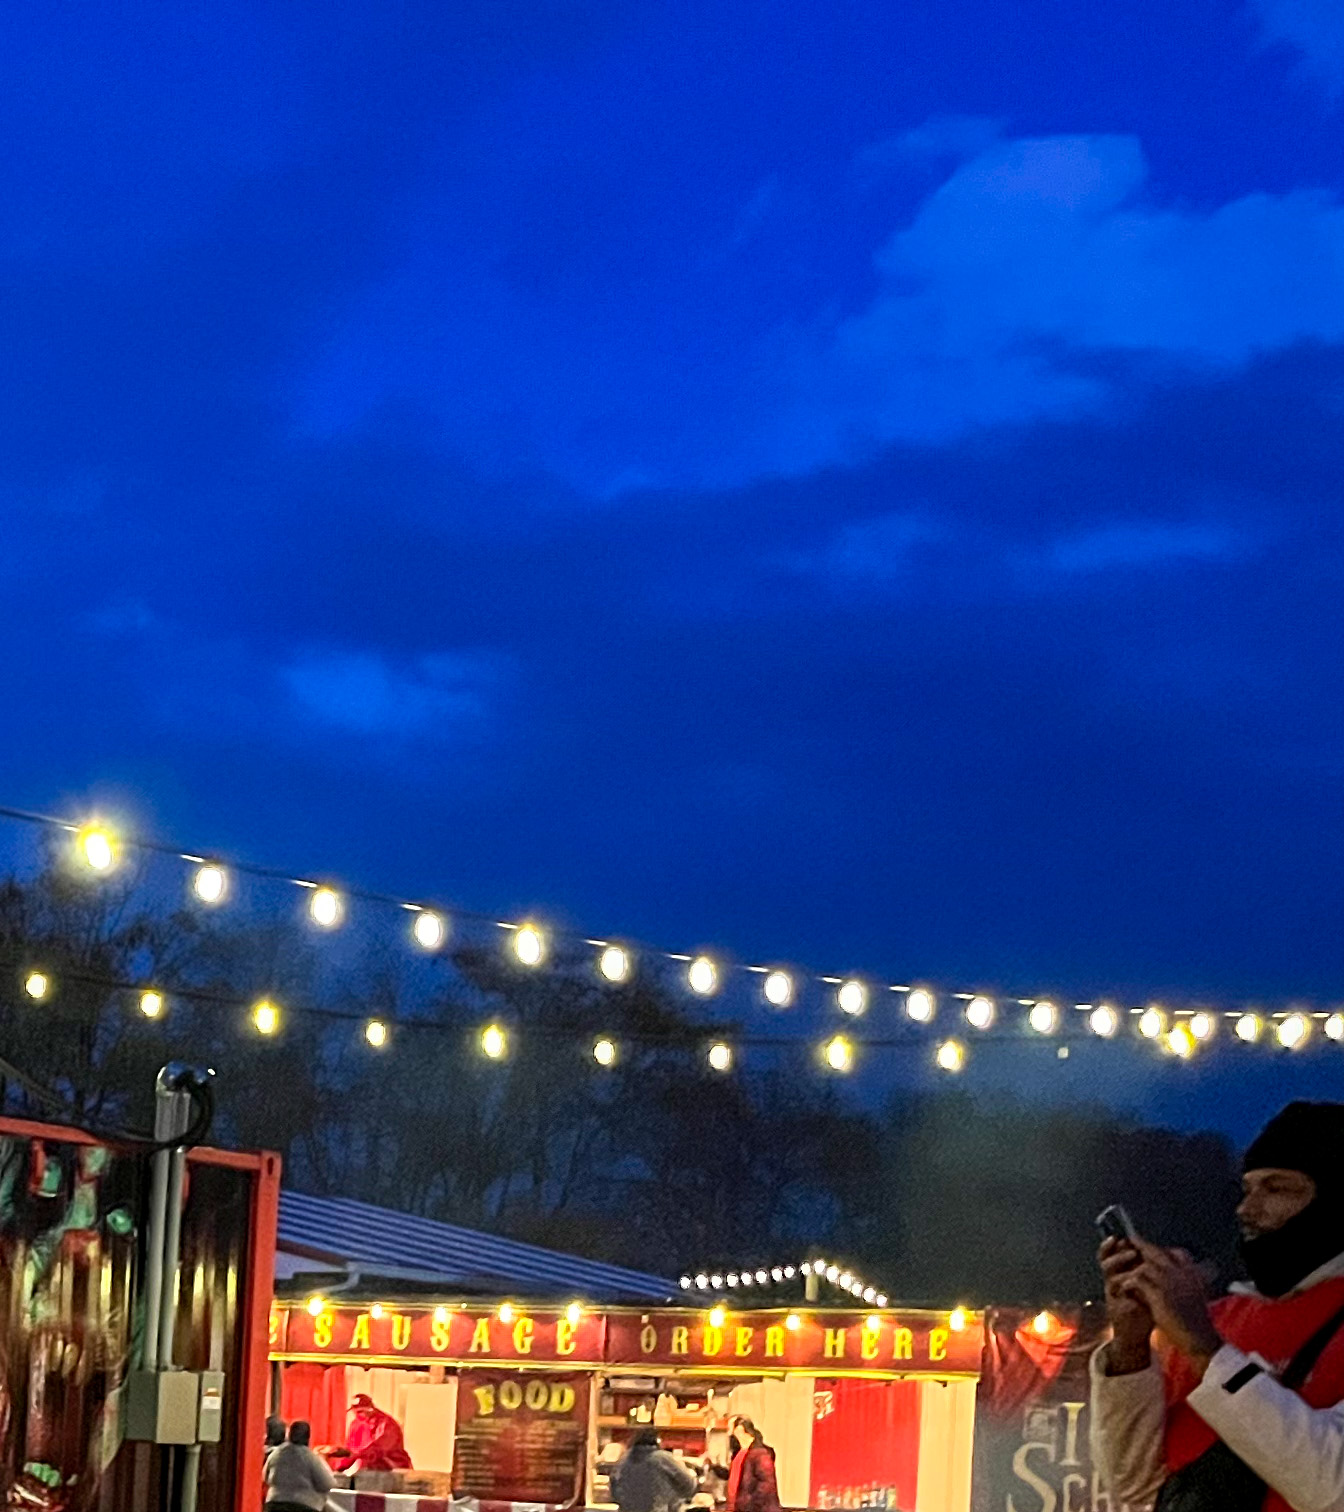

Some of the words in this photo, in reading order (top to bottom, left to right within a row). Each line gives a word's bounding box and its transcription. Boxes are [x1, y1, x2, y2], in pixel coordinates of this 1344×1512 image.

[313, 1312, 578, 1355] SAUSAGE
[640, 1325, 784, 1358] ORDER
[823, 1327, 949, 1361] HERE
[474, 1379, 576, 1416] FOOD
